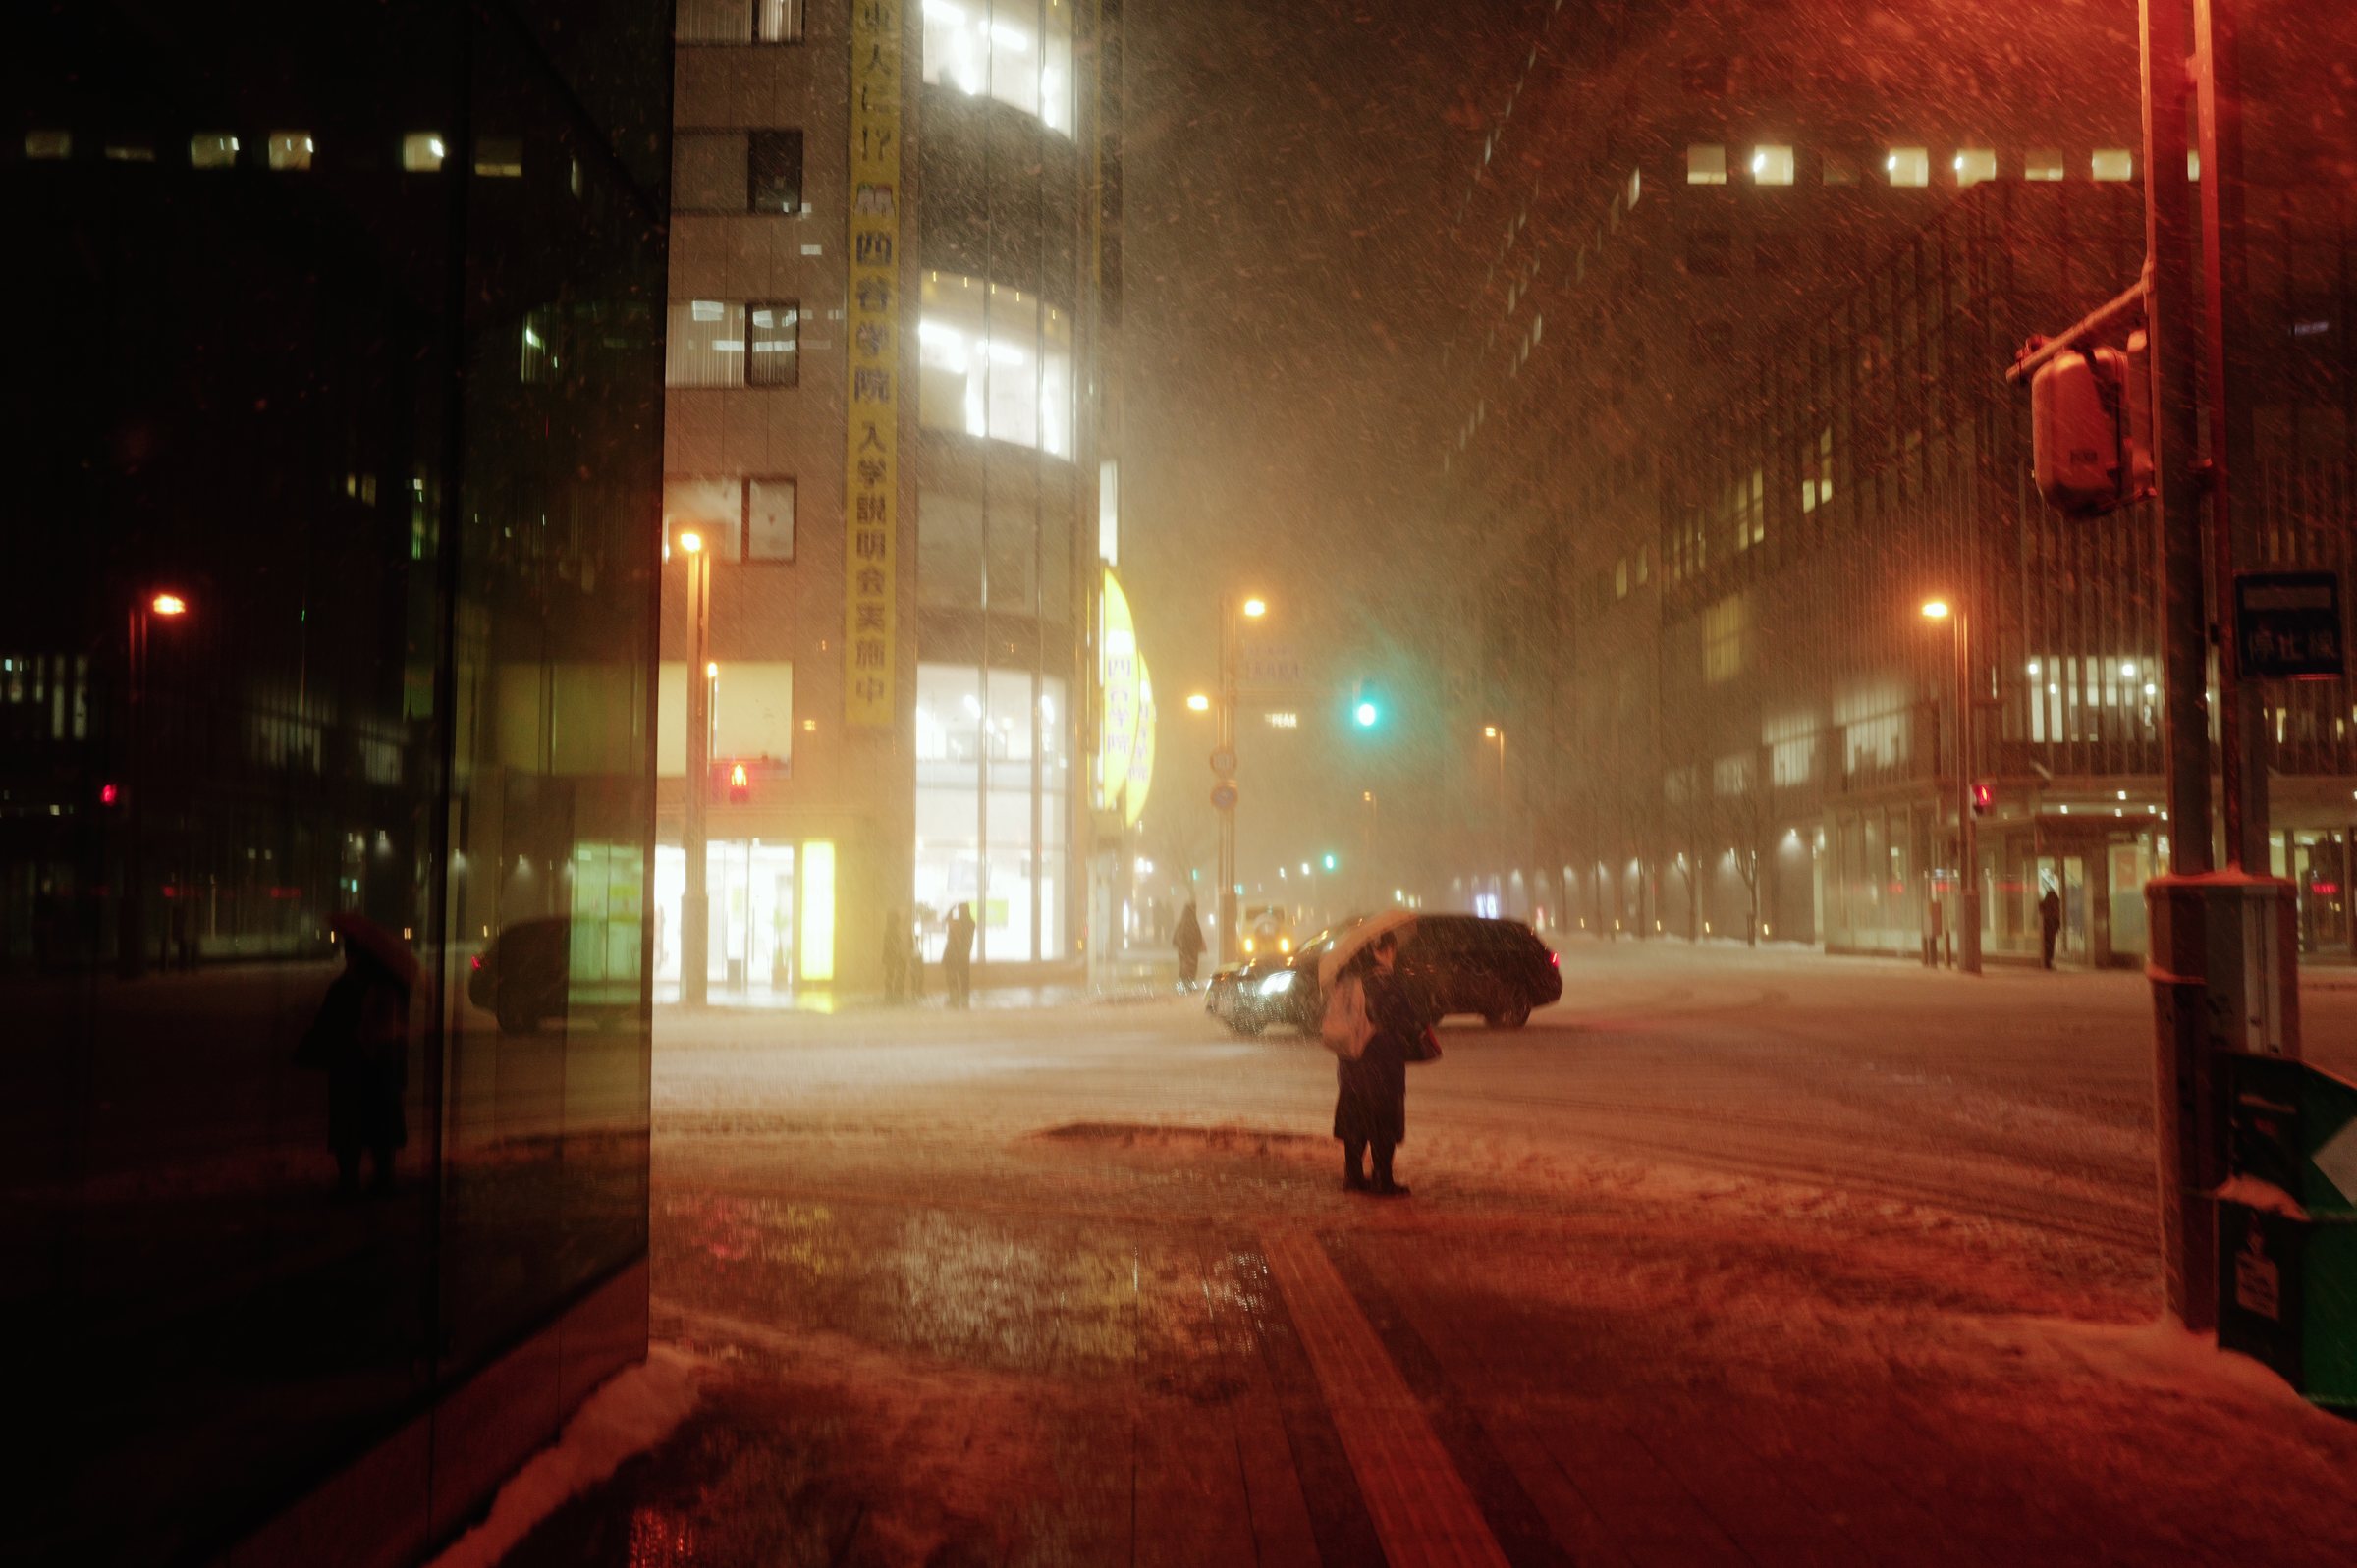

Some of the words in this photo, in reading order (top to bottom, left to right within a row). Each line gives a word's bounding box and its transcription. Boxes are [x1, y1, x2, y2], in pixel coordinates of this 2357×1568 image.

[853, 229, 893, 405] 四谷学院
[855, 420, 888, 704] 入学説明会実施中
